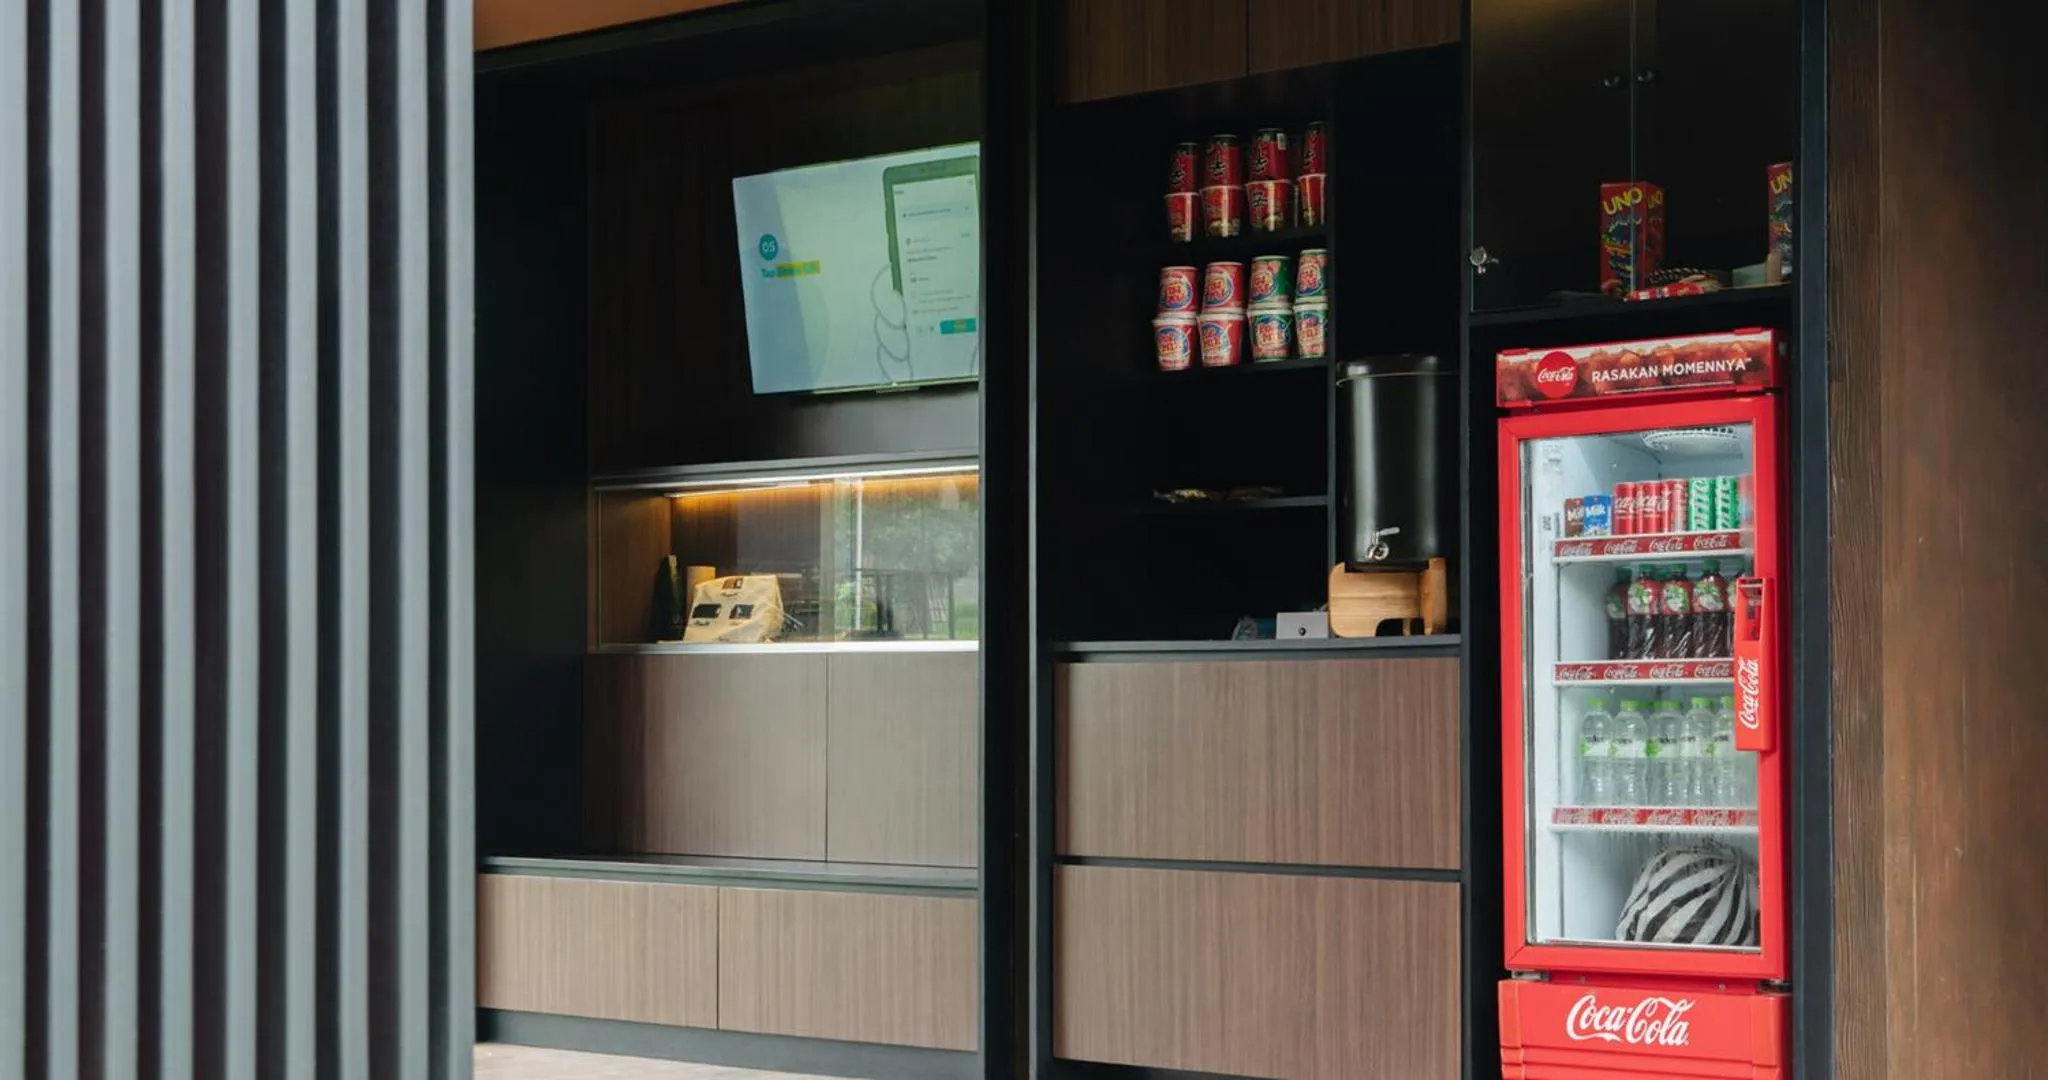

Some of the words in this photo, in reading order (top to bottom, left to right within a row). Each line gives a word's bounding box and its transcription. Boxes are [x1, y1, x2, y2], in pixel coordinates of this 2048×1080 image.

[1603, 187, 1643, 214] UNO
[762, 240, 776, 253] 05
[1592, 365, 1659, 383] RASAKAN
[1738, 656, 1759, 729] Coca-Cola
[1566, 994, 1696, 1046] Coca-Cola
